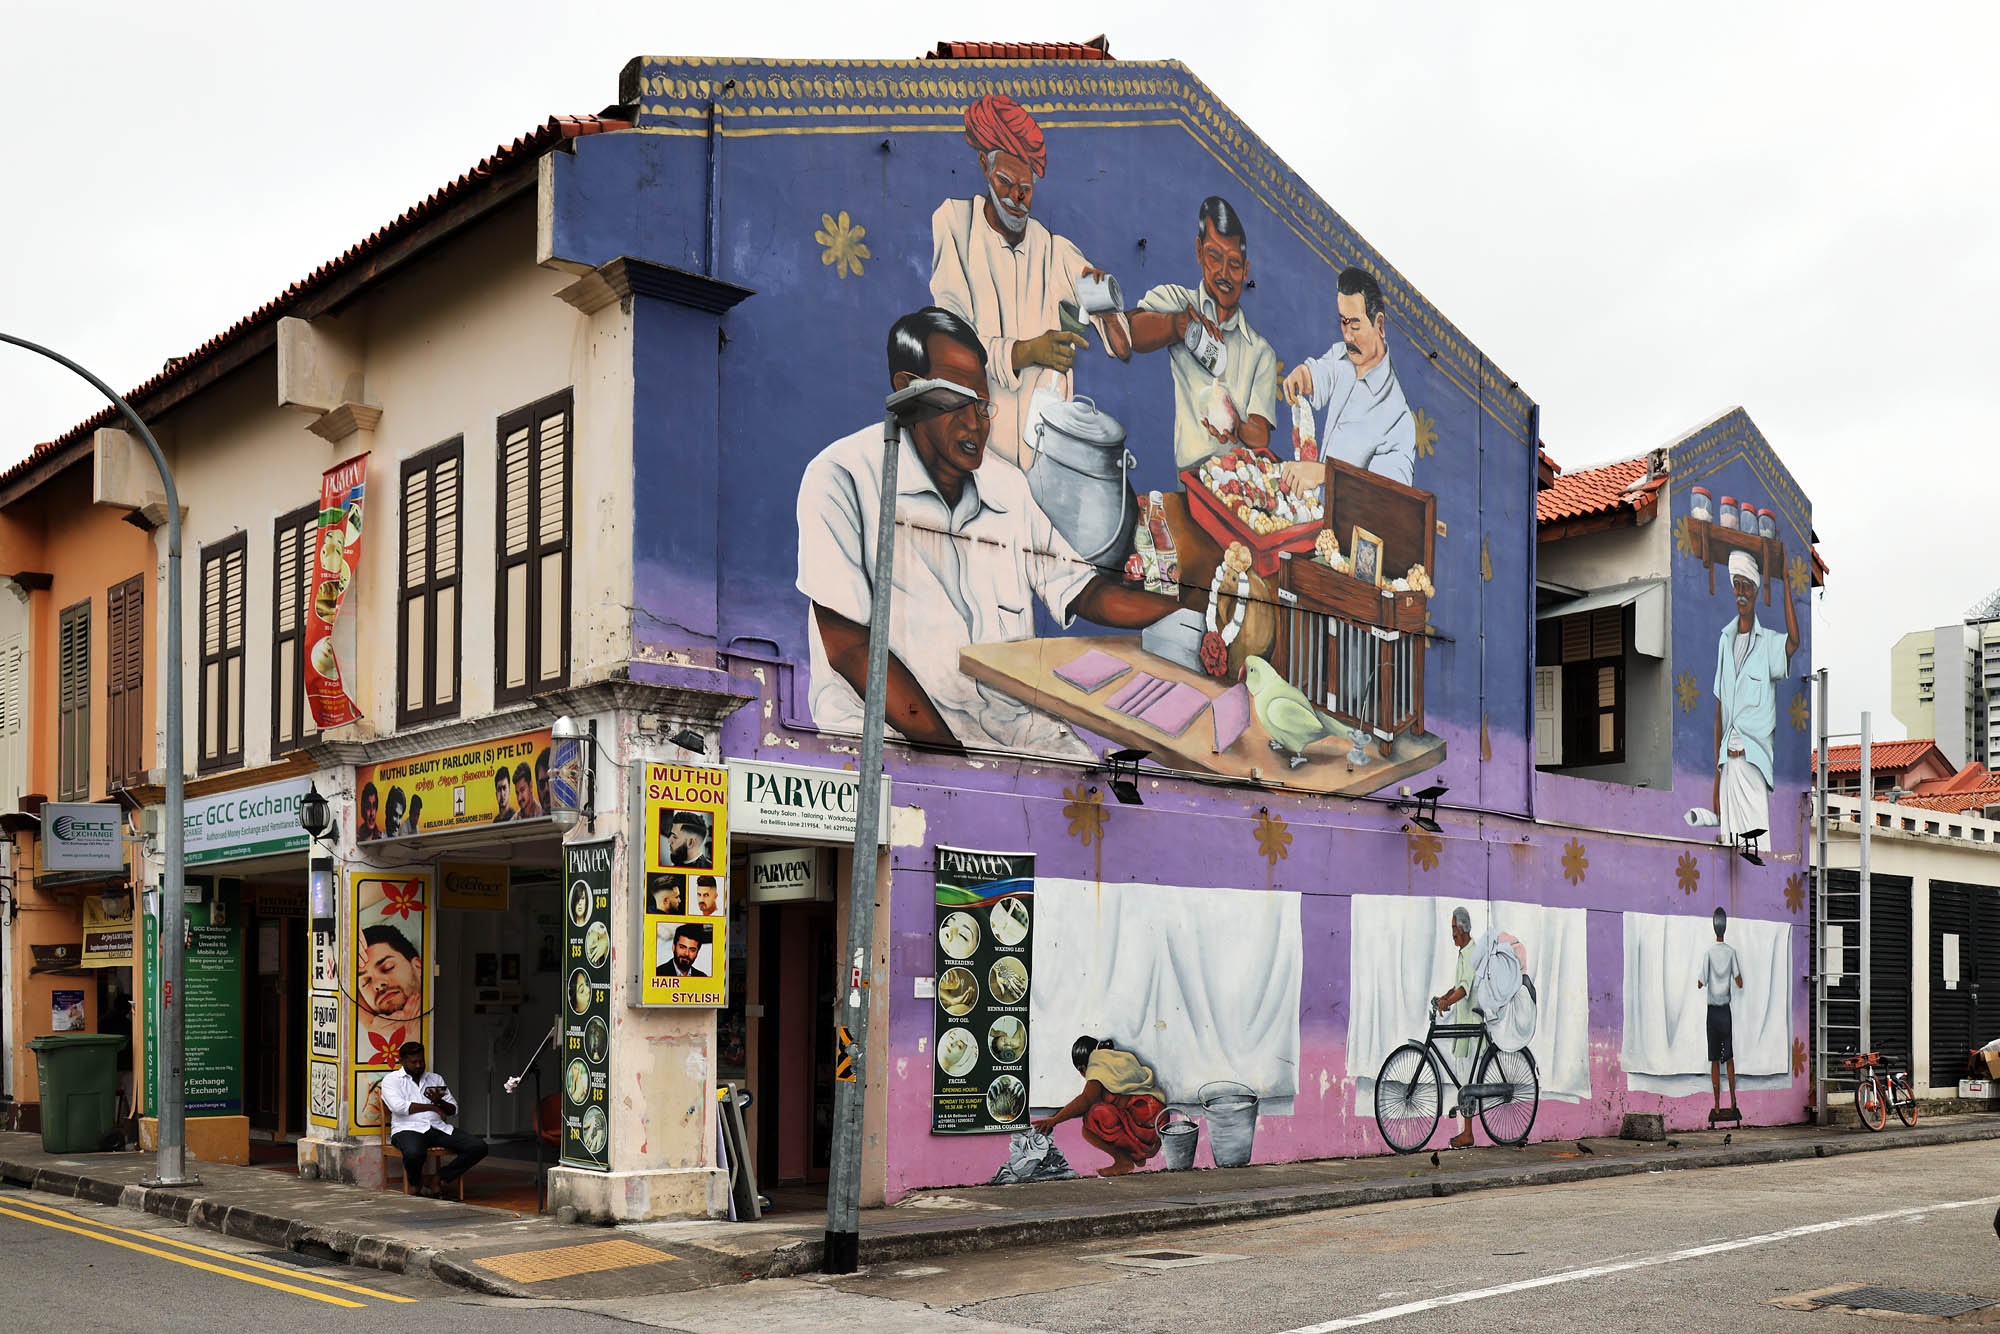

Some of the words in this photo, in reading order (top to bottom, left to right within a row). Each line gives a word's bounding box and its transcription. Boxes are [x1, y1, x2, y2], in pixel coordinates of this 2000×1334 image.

[379, 766, 407, 782] MUTHU
[409, 760, 440, 776] BEAUTY
[443, 752, 481, 770] PARLOUR
[483, 748, 495, 765] (S)
[497, 745, 514, 760] PTE
[516, 742, 533, 756] LTD
[652, 766, 723, 787] MUTHU
[648, 784, 725, 805] SALOON
[206, 802, 235, 825] GCC
[239, 794, 302, 820] Exchang
[760, 808, 780, 817] Beauty
[801, 811, 824, 820] Tailoring
[71, 822, 113, 831] GCC
[596, 896, 607, 909] $10
[651, 977, 680, 988] HAIR
[596, 990, 604, 1003] $5
[671, 992, 720, 1004] STYLISH
[313, 1030, 336, 1049] SALON
[190, 1078, 225, 1086] Exchange
[191, 1086, 228, 1095] Exchange!
[593, 1088, 603, 1101] $15
